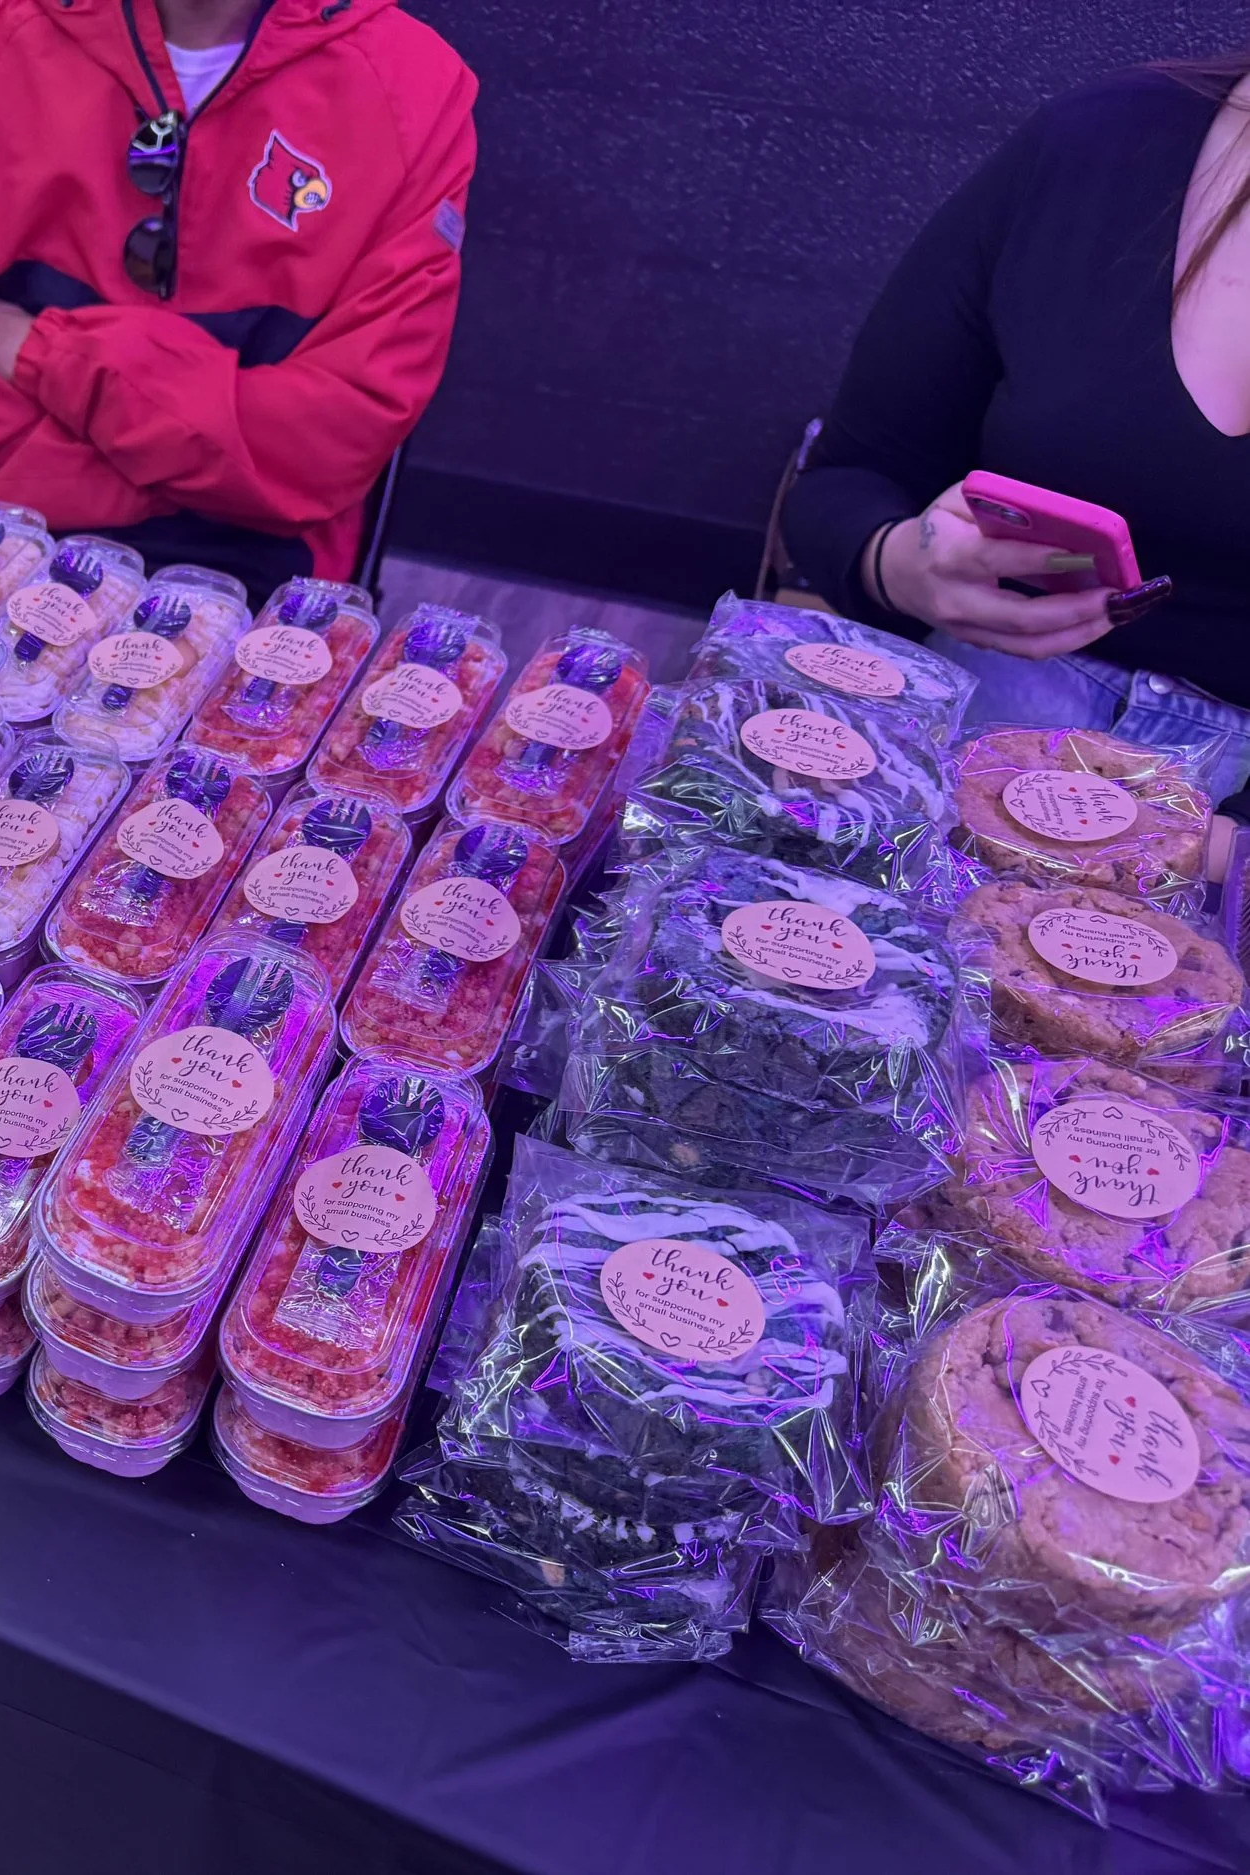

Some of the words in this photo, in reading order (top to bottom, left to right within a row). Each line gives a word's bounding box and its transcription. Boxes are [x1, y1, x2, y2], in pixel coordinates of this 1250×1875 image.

[114, 638, 164, 653] thank
[268, 643, 302, 655] you
[270, 630, 320, 651] thank
[120, 650, 154, 661] you
[394, 682, 430, 698] you
[397, 668, 448, 695] thank
[542, 703, 580, 718] you
[545, 689, 599, 714] thank
[778, 714, 848, 740] thank
[786, 730, 832, 745] you
[154, 820, 190, 842] you
[157, 804, 208, 838] thank
[280, 852, 339, 875] thank
[282, 870, 323, 886] you
[442, 883, 502, 915] thank
[441, 901, 485, 919] you
[767, 907, 847, 937] thank
[774, 927, 829, 944] you
[1076, 945, 1125, 958] you
[1062, 954, 1142, 978] thank
[183, 1035, 254, 1073] thank
[179, 1059, 230, 1081] you
[160, 1083, 183, 1094] small
[184, 1090, 223, 1112] business
[173, 1077, 218, 1100] supporting
[220, 1096, 233, 1107] my
[3, 1118, 40, 1134] business
[36, 1118, 48, 1127] my
[1074, 1126, 1121, 1140] business
[1067, 1134, 1083, 1142] my
[1086, 1138, 1142, 1152] supporting
[1124, 1135, 1153, 1144] small
[1145, 1148, 1160, 1156] for
[341, 1154, 413, 1186] thank
[1086, 1154, 1141, 1174] you
[341, 1180, 392, 1199] you
[1068, 1171, 1160, 1206] thank
[337, 1201, 385, 1215] supporting
[386, 1212, 400, 1221] my
[351, 1211, 391, 1228] business
[651, 1247, 734, 1290] thank
[656, 1276, 713, 1301] you
[635, 1289, 649, 1297] for
[652, 1296, 706, 1321] supporting
[709, 1317, 725, 1328] my
[639, 1302, 667, 1316] small
[669, 1312, 715, 1335] business
[1104, 1399, 1136, 1452] you
[1134, 1410, 1183, 1488] thank
